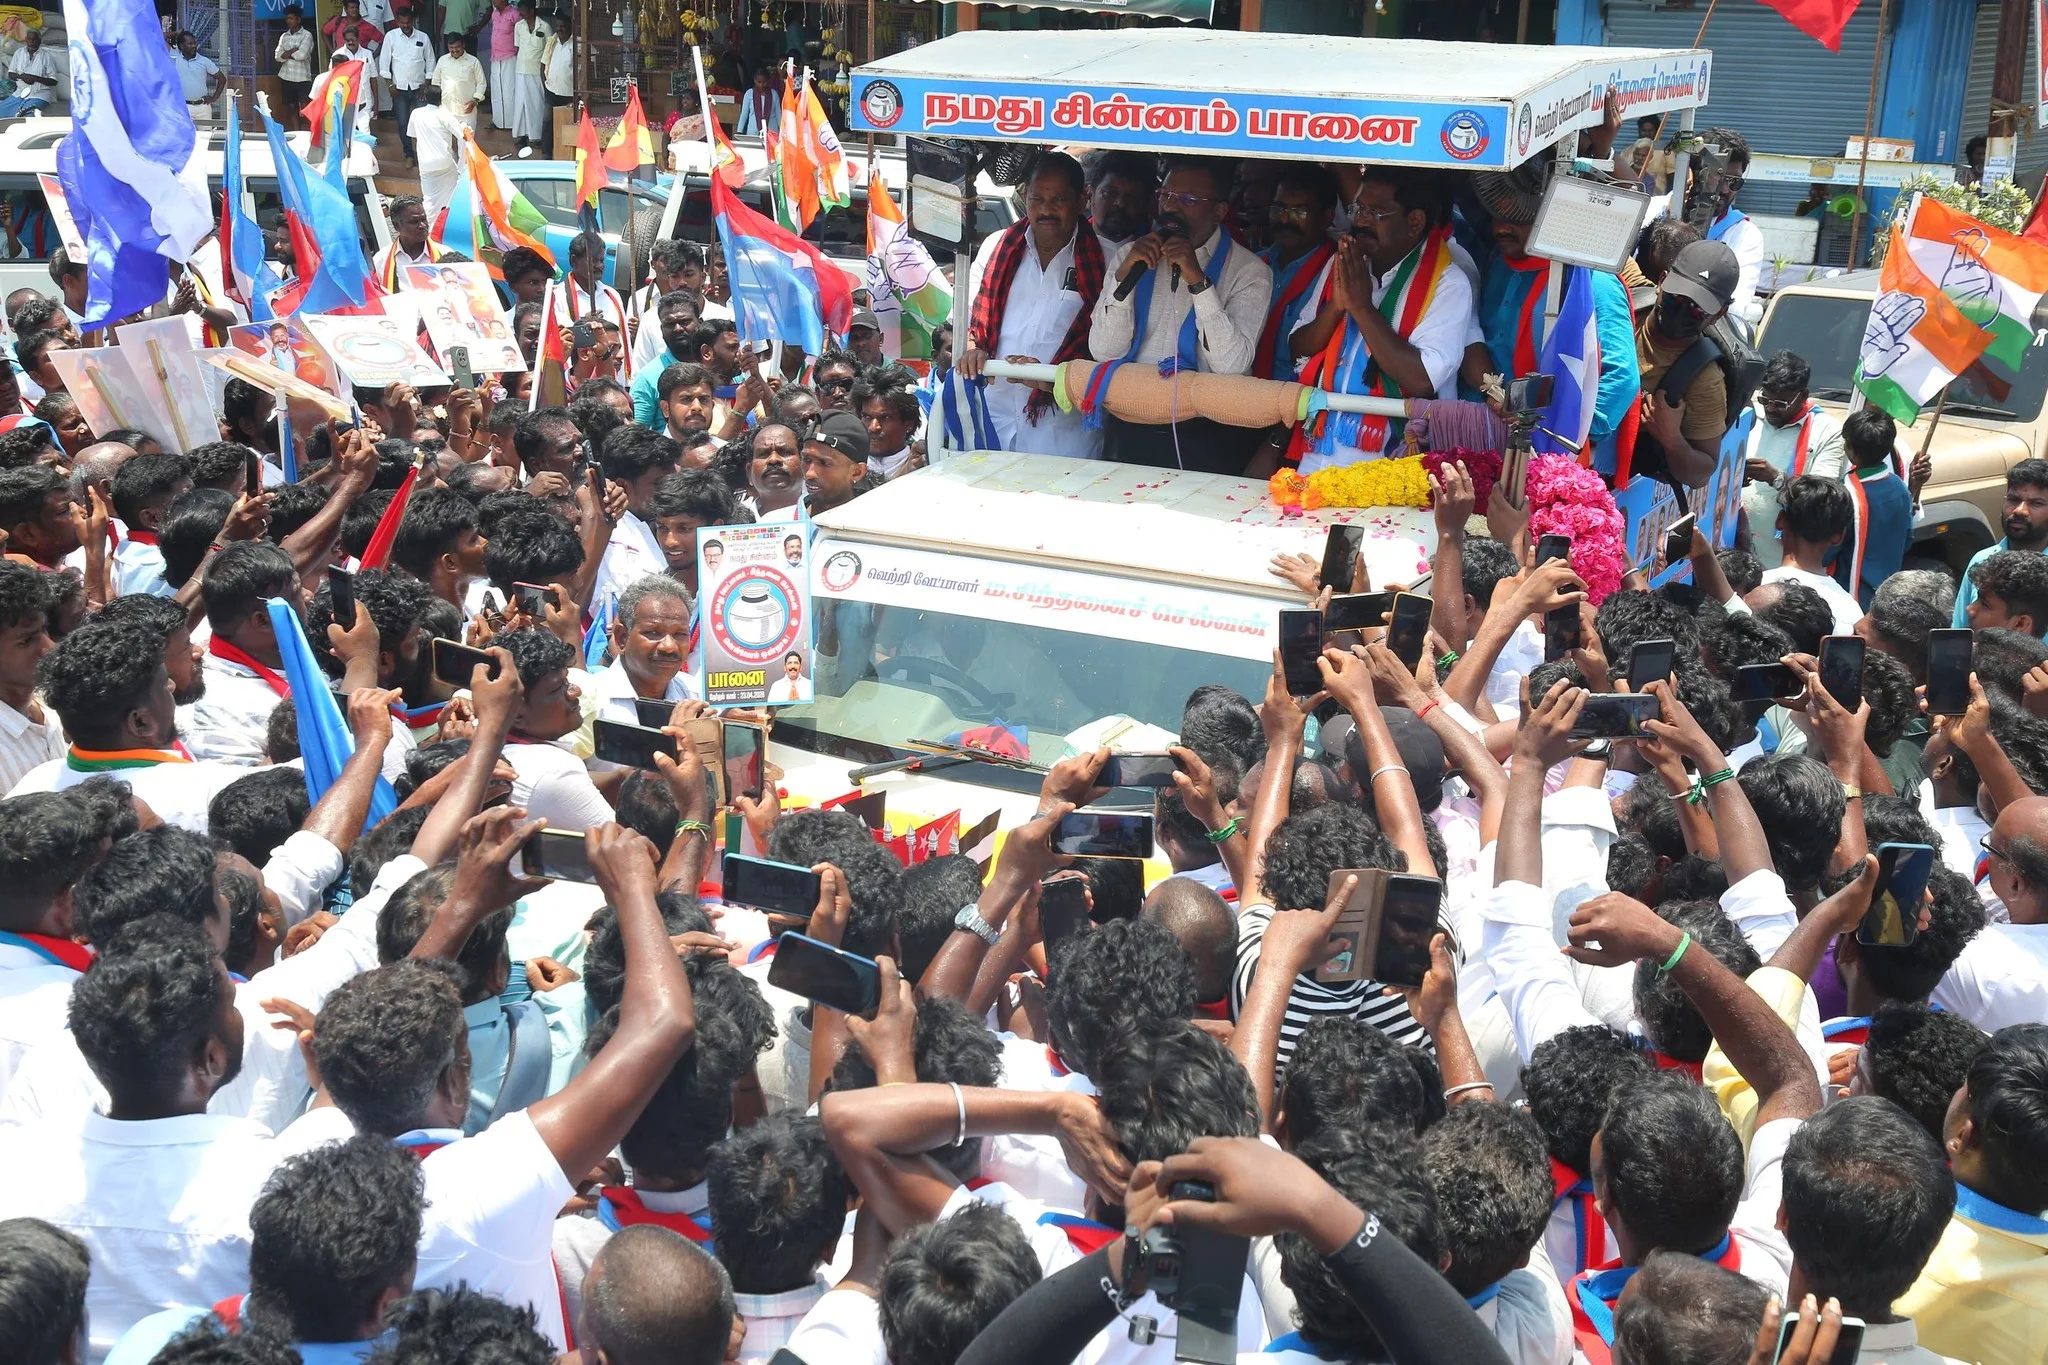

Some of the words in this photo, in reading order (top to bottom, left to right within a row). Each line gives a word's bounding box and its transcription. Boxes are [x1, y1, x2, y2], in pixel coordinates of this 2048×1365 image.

[925, 94, 1042, 132] நமது
[1052, 95, 1237, 133] சின்னம்
[1248, 111, 1418, 144] பானை
[867, 567, 912, 586] வெற்றி
[913, 571, 980, 594] வேட்பாளர்
[983, 577, 1147, 618] ம.சிந்தனைச்
[1150, 601, 1271, 637] செல்வன்
[708, 669, 766, 689] பானை
